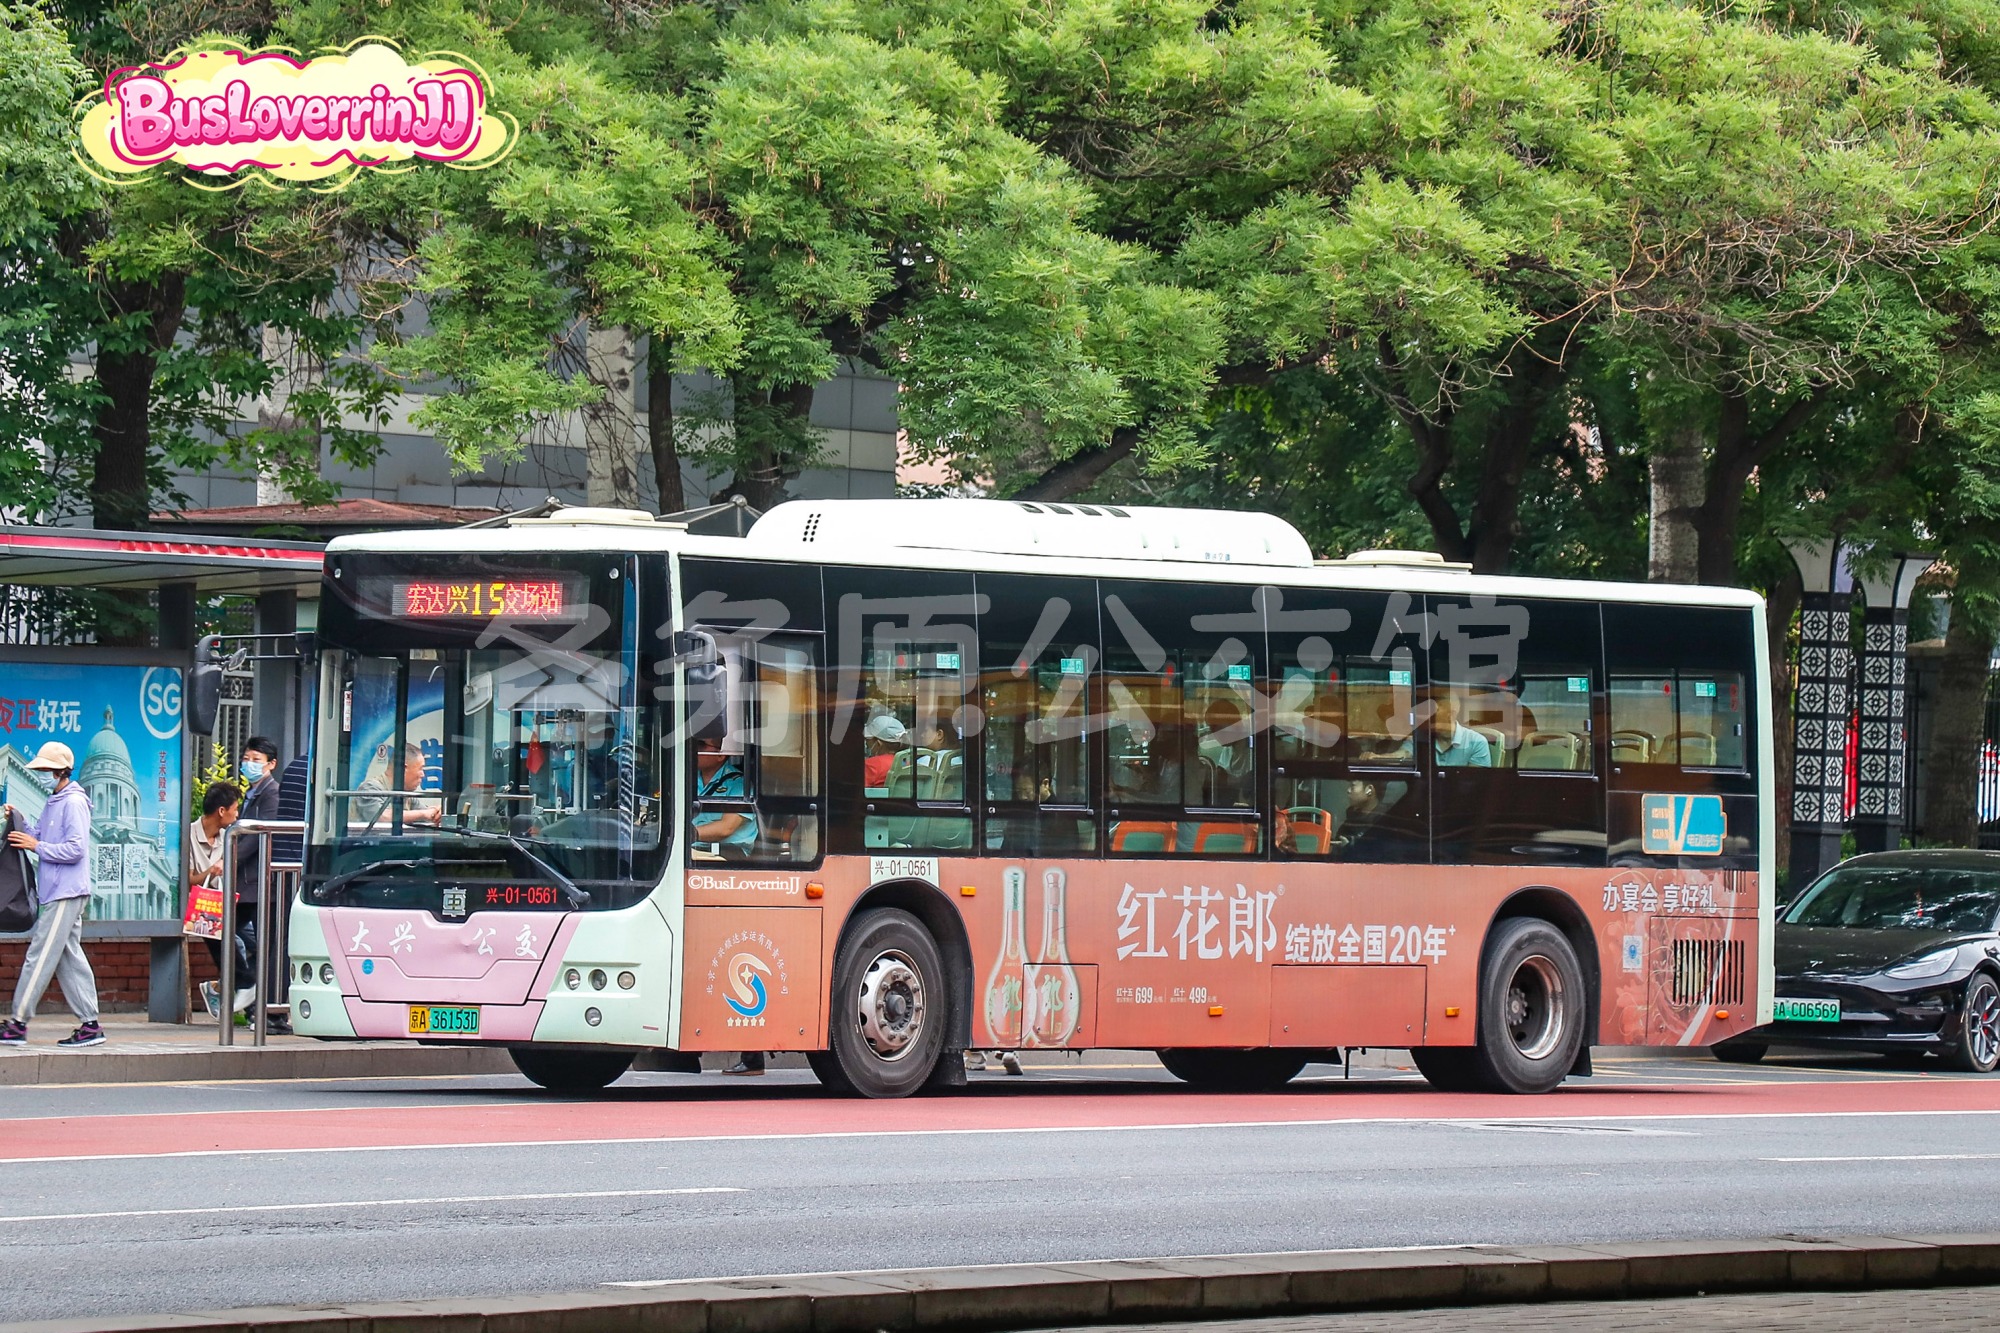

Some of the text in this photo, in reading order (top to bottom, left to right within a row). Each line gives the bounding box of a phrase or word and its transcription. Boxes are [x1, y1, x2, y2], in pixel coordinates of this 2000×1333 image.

[147, 683, 182, 716] SG
[158, 751, 167, 802] 艺术殿堂
[874, 859, 932, 877] 兴-01-0561
[486, 887, 557, 904] 兴-01-0561
[1603, 880, 1717, 913] 办宴会 享好礼
[349, 920, 538, 959] 大兴 公交
[1135, 987, 1153, 1004] 699
[1189, 987, 1207, 1004] 499
